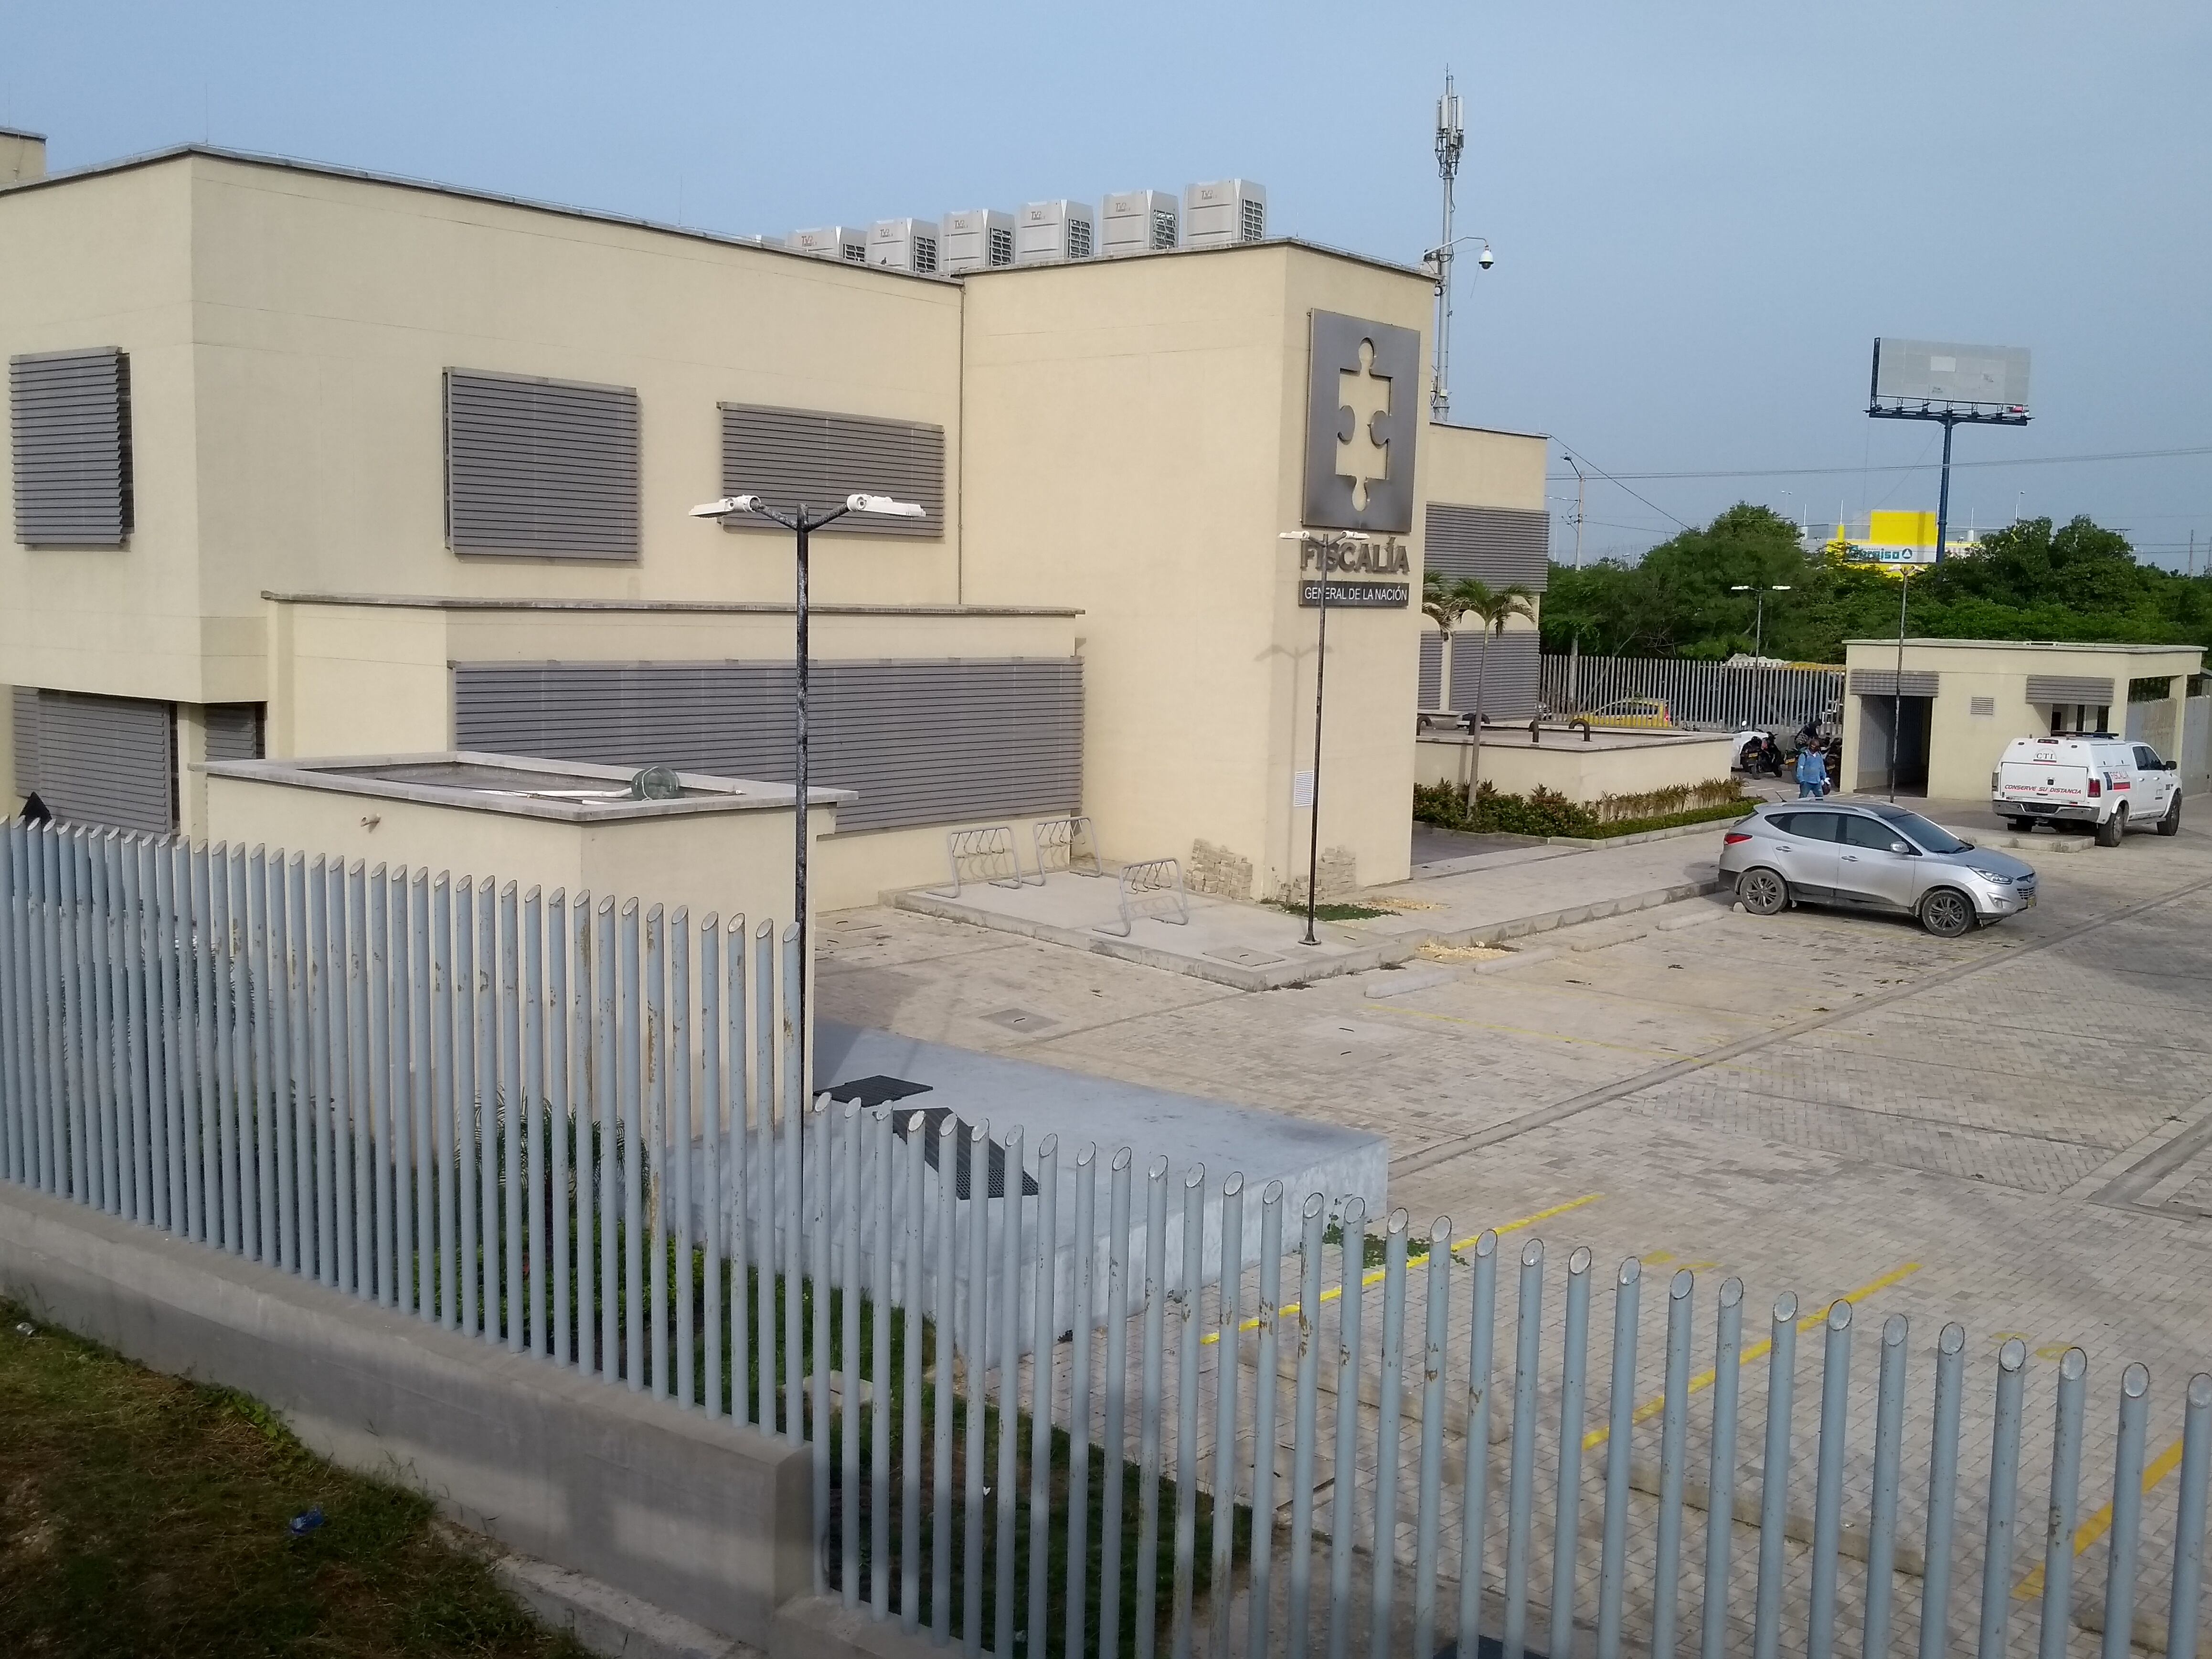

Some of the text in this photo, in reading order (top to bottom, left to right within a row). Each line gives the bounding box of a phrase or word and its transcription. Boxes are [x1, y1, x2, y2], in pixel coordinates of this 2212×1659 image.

[1349, 588, 1360, 600] DE
[1363, 588, 1373, 600] LA
[1375, 586, 1407, 601] NACIÓN
